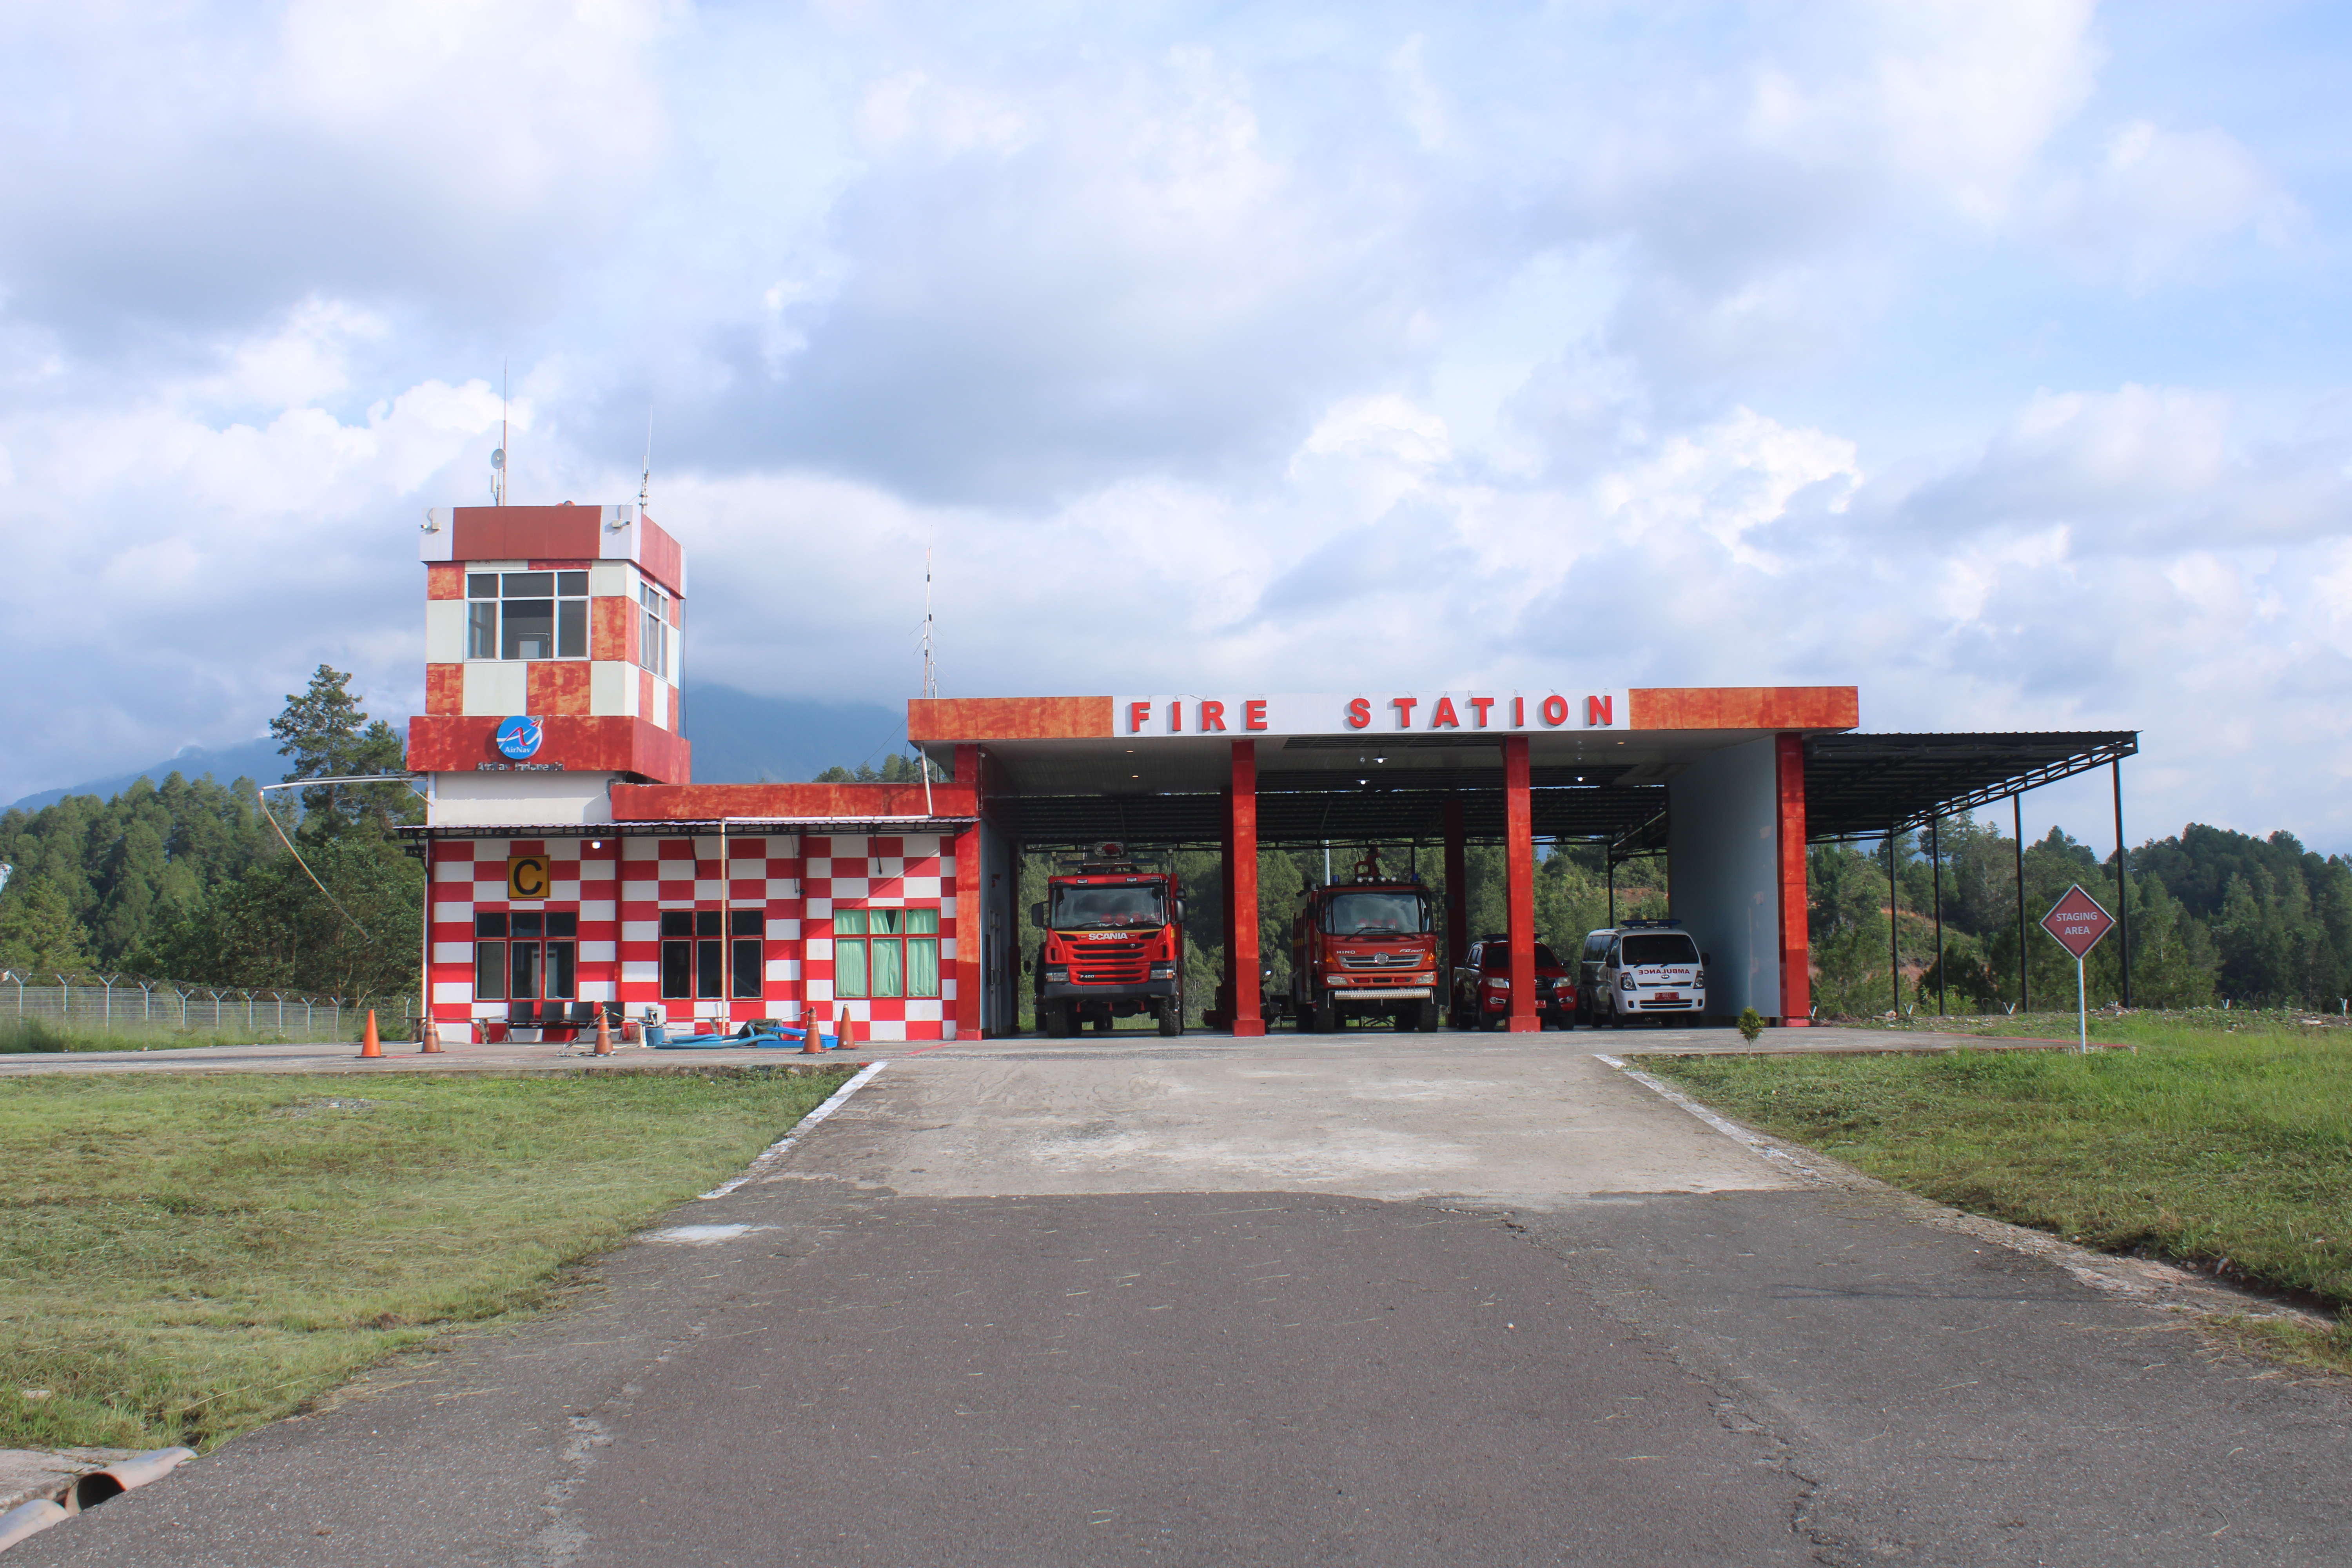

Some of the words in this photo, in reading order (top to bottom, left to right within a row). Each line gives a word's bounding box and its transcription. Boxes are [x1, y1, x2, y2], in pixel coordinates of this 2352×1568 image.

[1131, 700, 1268, 731] FIRE
[1349, 695, 1612, 728] STATION
[514, 859, 543, 895] C
[2056, 911, 2098, 922] STAGING
[2064, 926, 2091, 935] AREA
